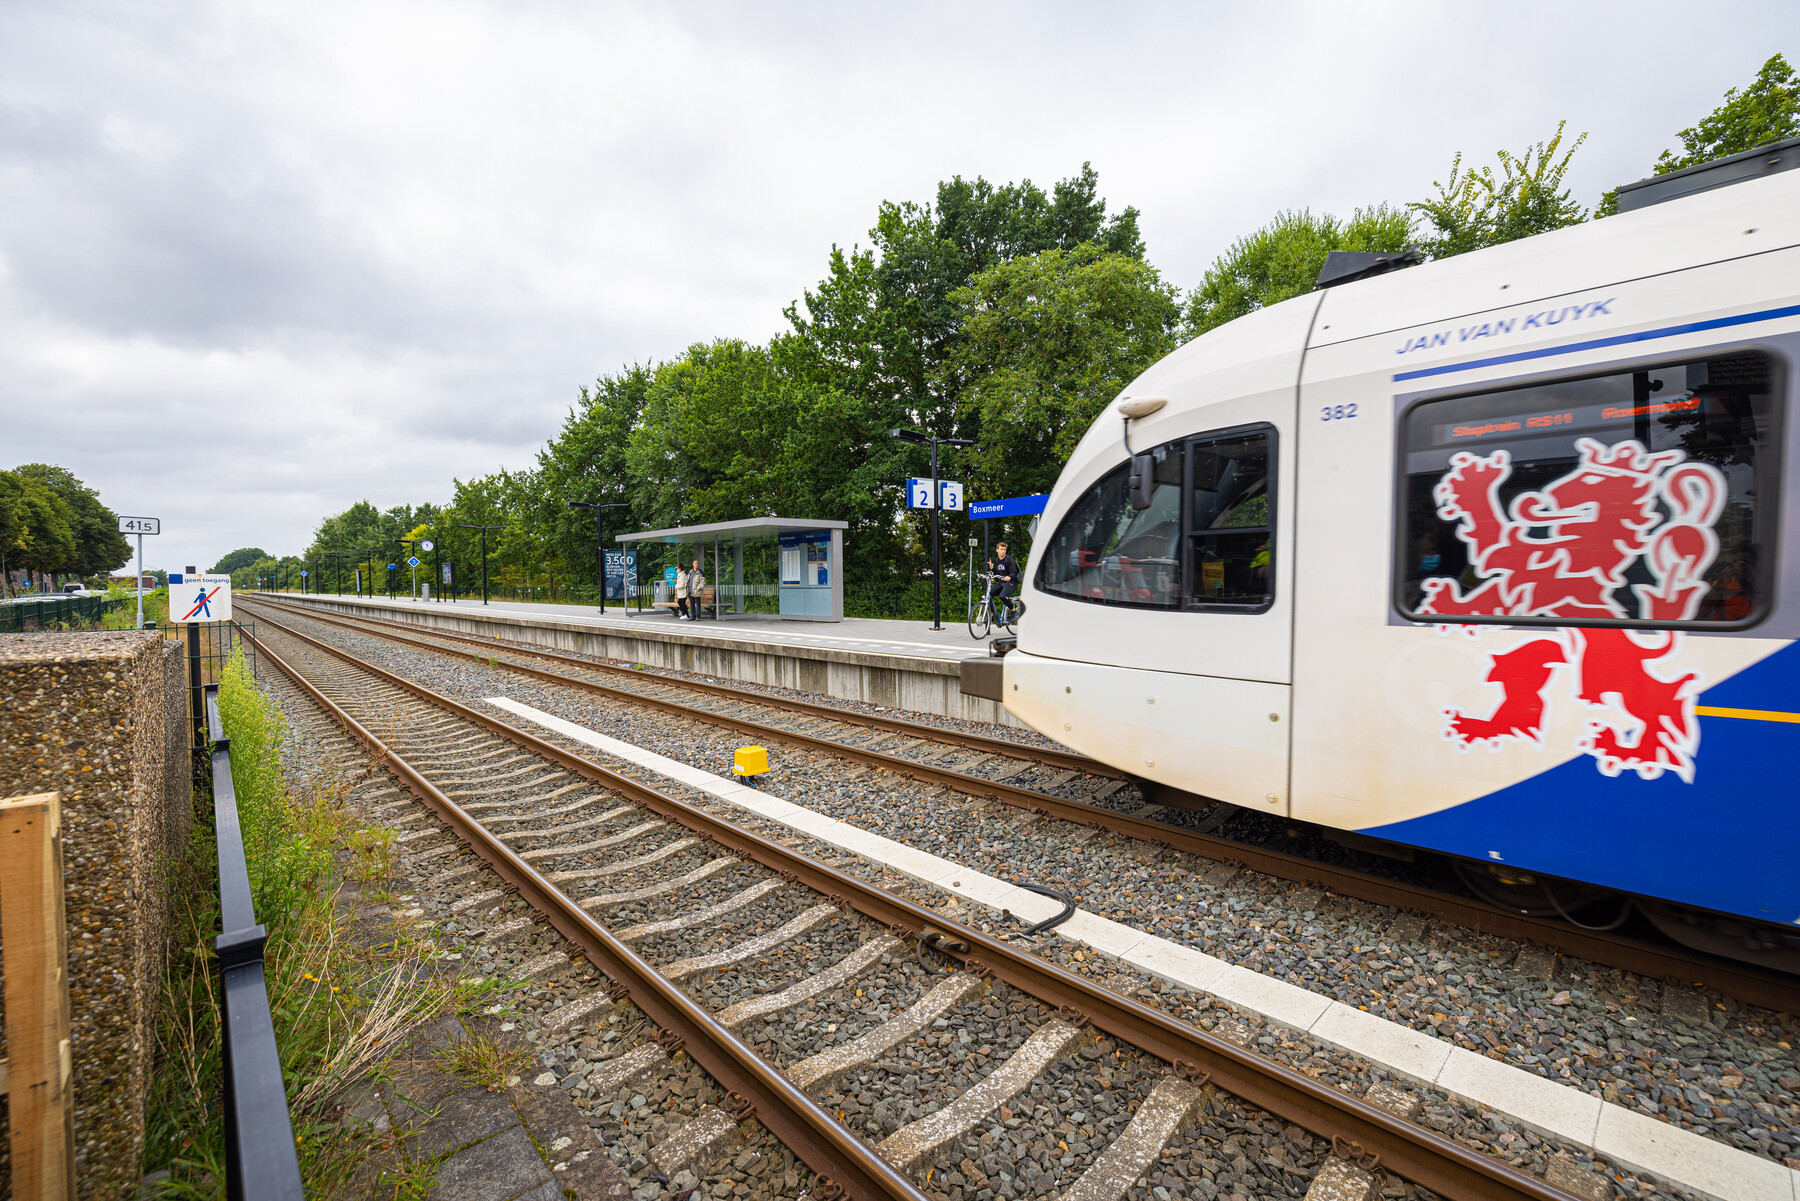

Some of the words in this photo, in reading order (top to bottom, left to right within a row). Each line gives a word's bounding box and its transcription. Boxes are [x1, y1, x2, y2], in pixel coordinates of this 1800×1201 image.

[1396, 330, 1452, 355] JAN
[1458, 317, 1518, 342] VAN
[1521, 297, 1618, 331] KUYK
[1320, 403, 1358, 421] 382
[920, 490, 928, 506] 2
[949, 492, 957, 509] 3
[973, 504, 1004, 514] Boxmeer
